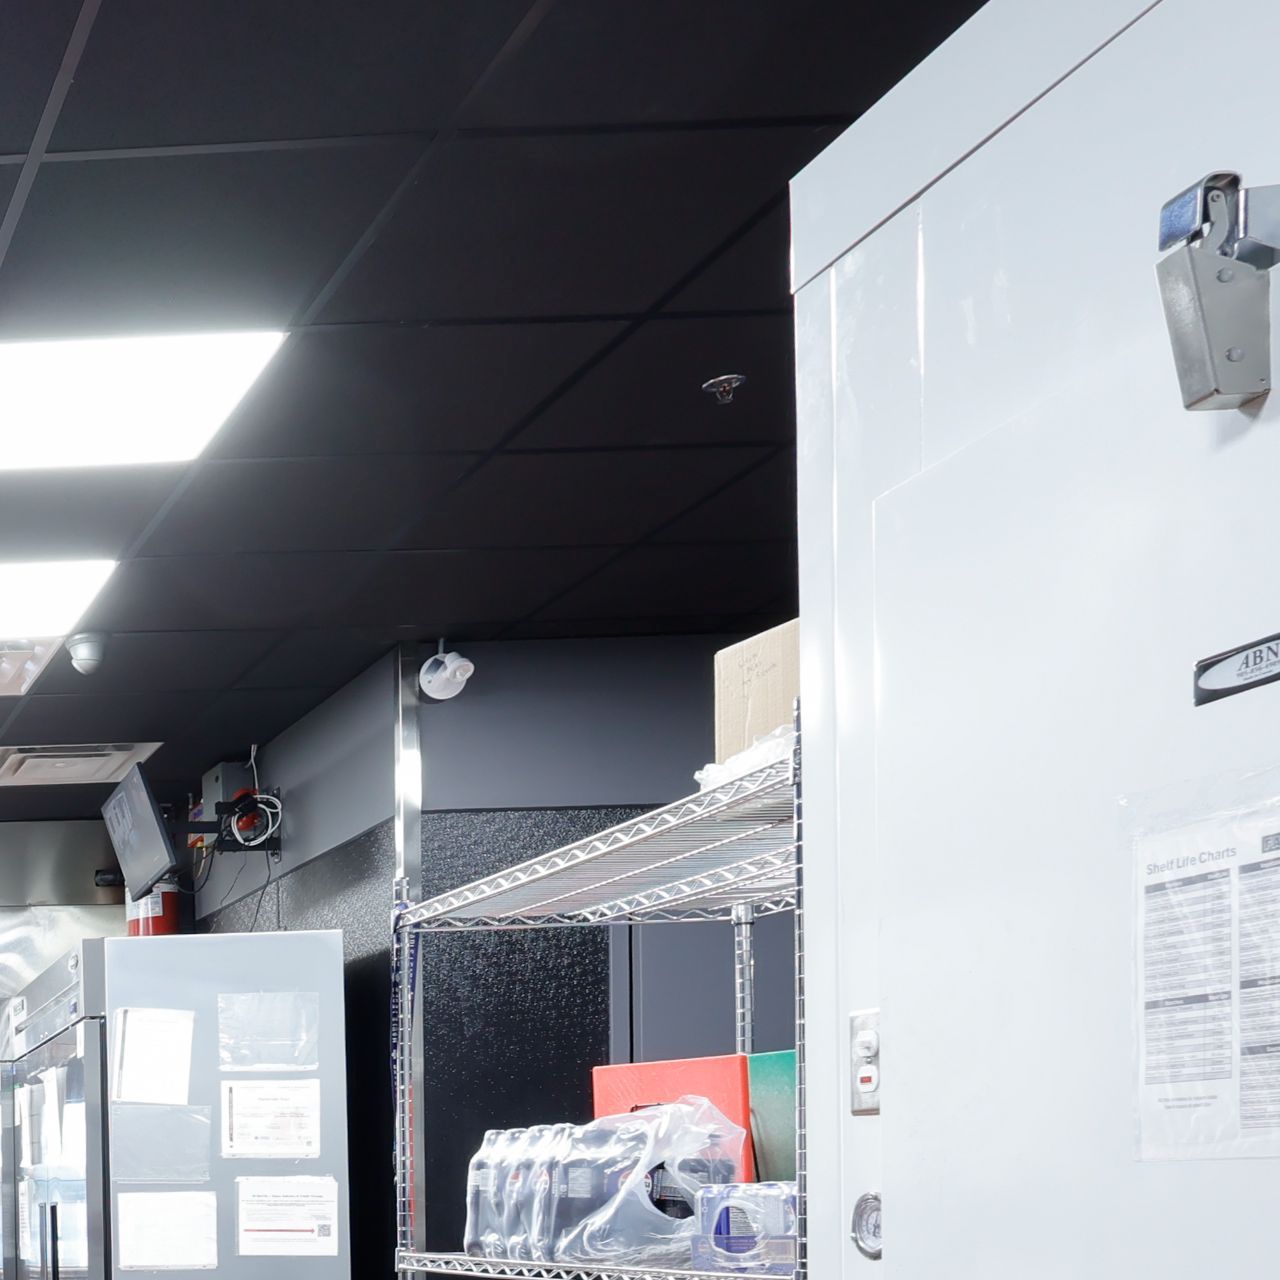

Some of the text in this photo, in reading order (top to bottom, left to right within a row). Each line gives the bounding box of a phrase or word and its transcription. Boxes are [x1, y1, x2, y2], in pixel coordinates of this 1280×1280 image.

[1146, 847, 1237, 876] Shelf Life Charts
